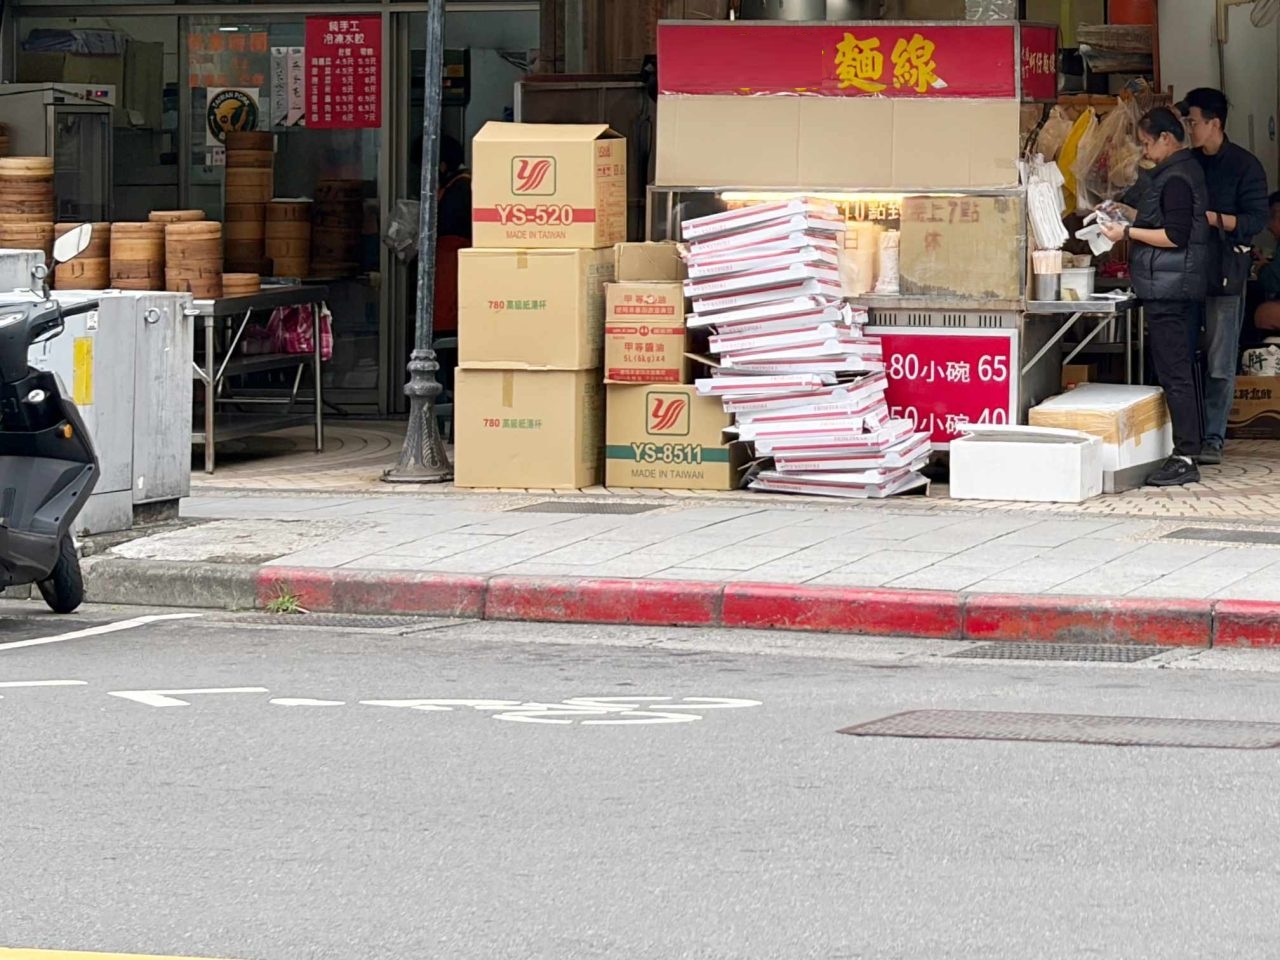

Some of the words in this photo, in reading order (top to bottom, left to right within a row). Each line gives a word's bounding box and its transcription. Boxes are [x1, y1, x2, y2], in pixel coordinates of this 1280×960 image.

[834, 32, 947, 93] 麵線
[495, 204, 574, 226] YS-520
[506, 230, 527, 239] MADE
[529, 230, 537, 239] IN
[538, 230, 566, 239] TAIWAN
[488, 300, 505, 309] 780
[623, 294, 667, 304] 甲等油
[890, 353, 919, 380] 80
[920, 360, 970, 383] 小碗
[977, 355, 1007, 382] 65
[483, 418, 500, 427] 780
[919, 413, 970, 435] 小碗
[631, 442, 702, 464] YS-8511
[631, 469, 656, 478] MADE
[659, 470, 668, 478] IN
[670, 470, 704, 479] TAIWAN
